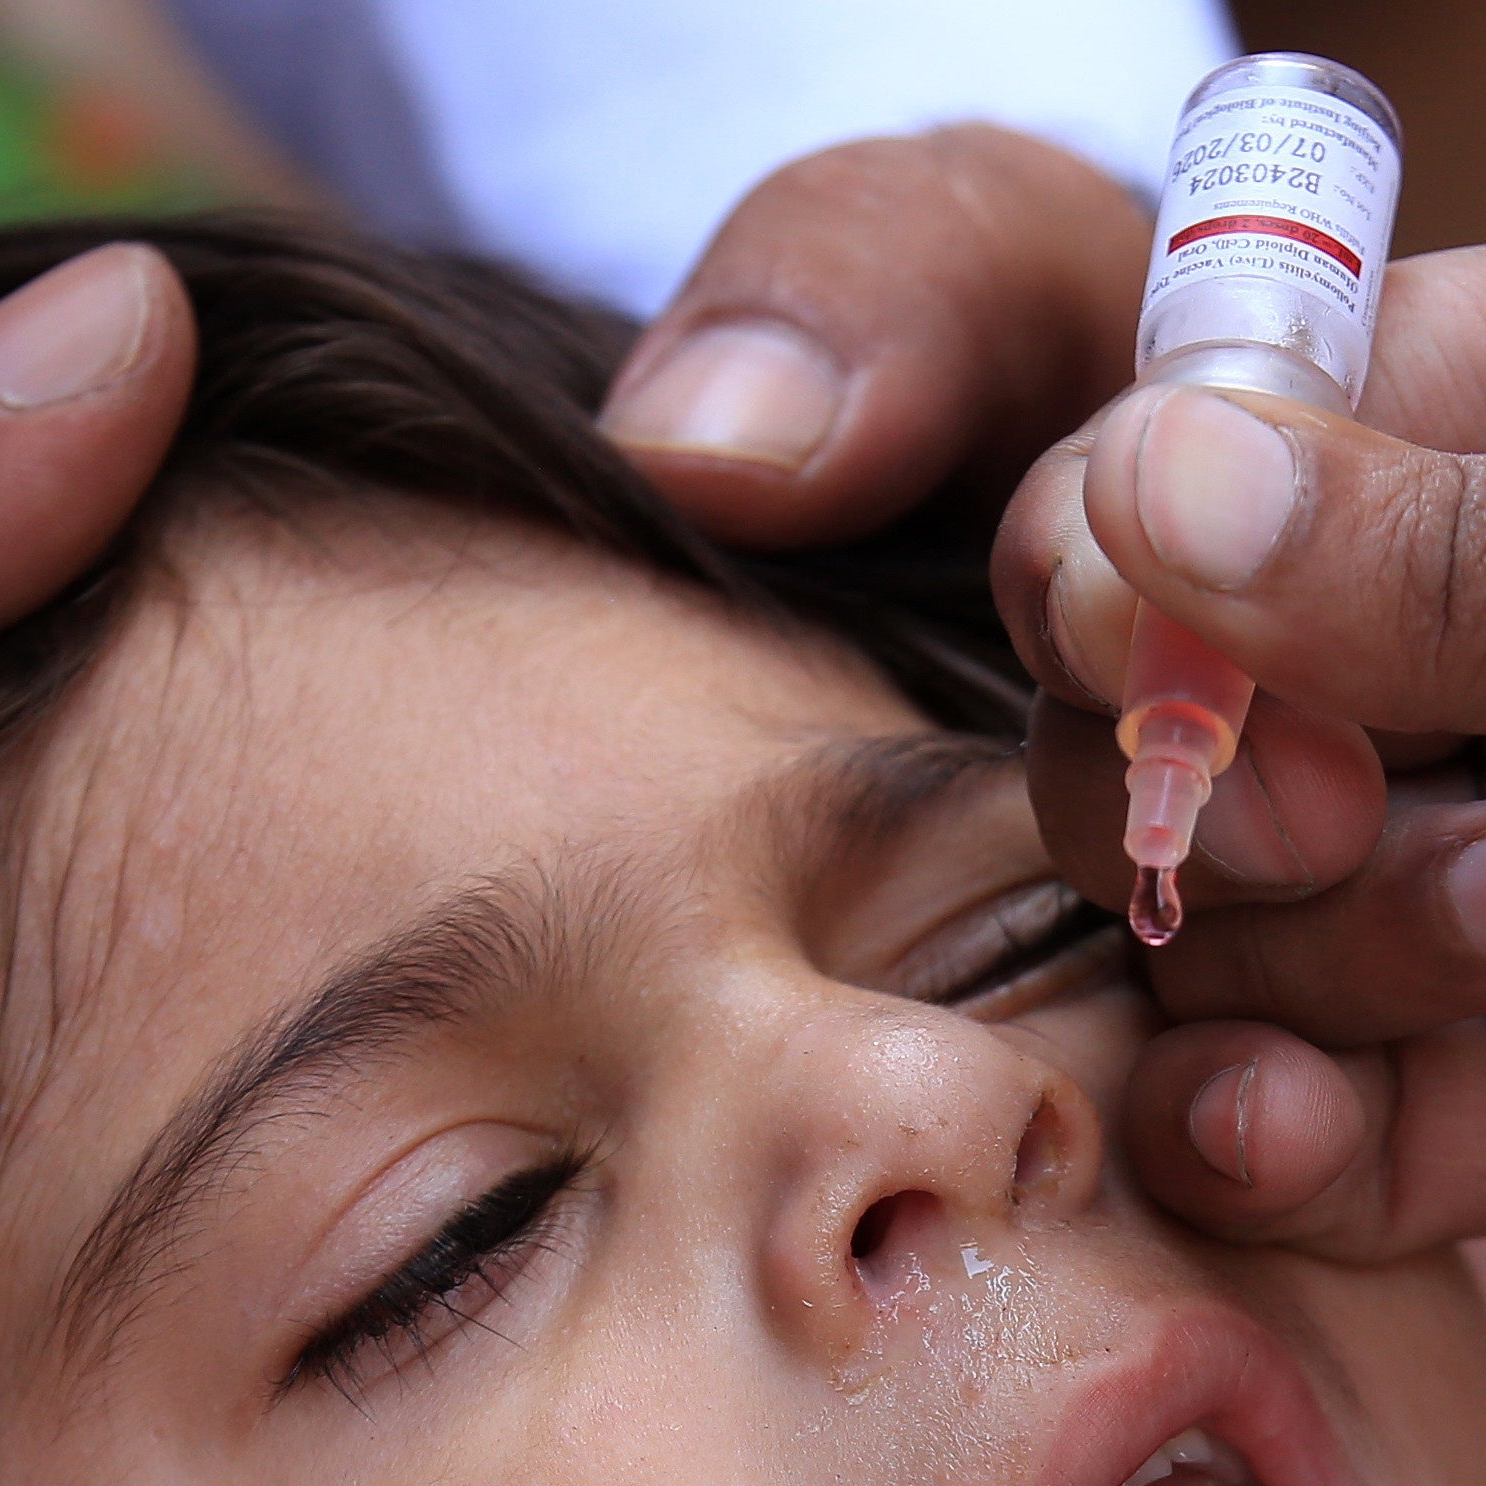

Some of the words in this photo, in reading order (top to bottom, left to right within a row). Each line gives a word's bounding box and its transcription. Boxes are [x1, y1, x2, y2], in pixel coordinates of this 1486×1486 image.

[1258, 98, 1277, 109] of
[1279, 98, 1340, 122] Institute
[1262, 114, 1285, 127] by:
[1291, 119, 1379, 172] Manufactured
[1172, 133, 1325, 183] 07/03/2026
[1189, 164, 1322, 196] B2403024
[1213, 200, 1297, 214] Requirements
[1300, 209, 1332, 230] WHO
[1178, 244, 1207, 263] Oral
[1256, 239, 1309, 261] Diploid
[1173, 258, 1223, 278] Vaccine
[1229, 256, 1274, 269] (Live)
[1279, 261, 1355, 313] Poliomyelitis
